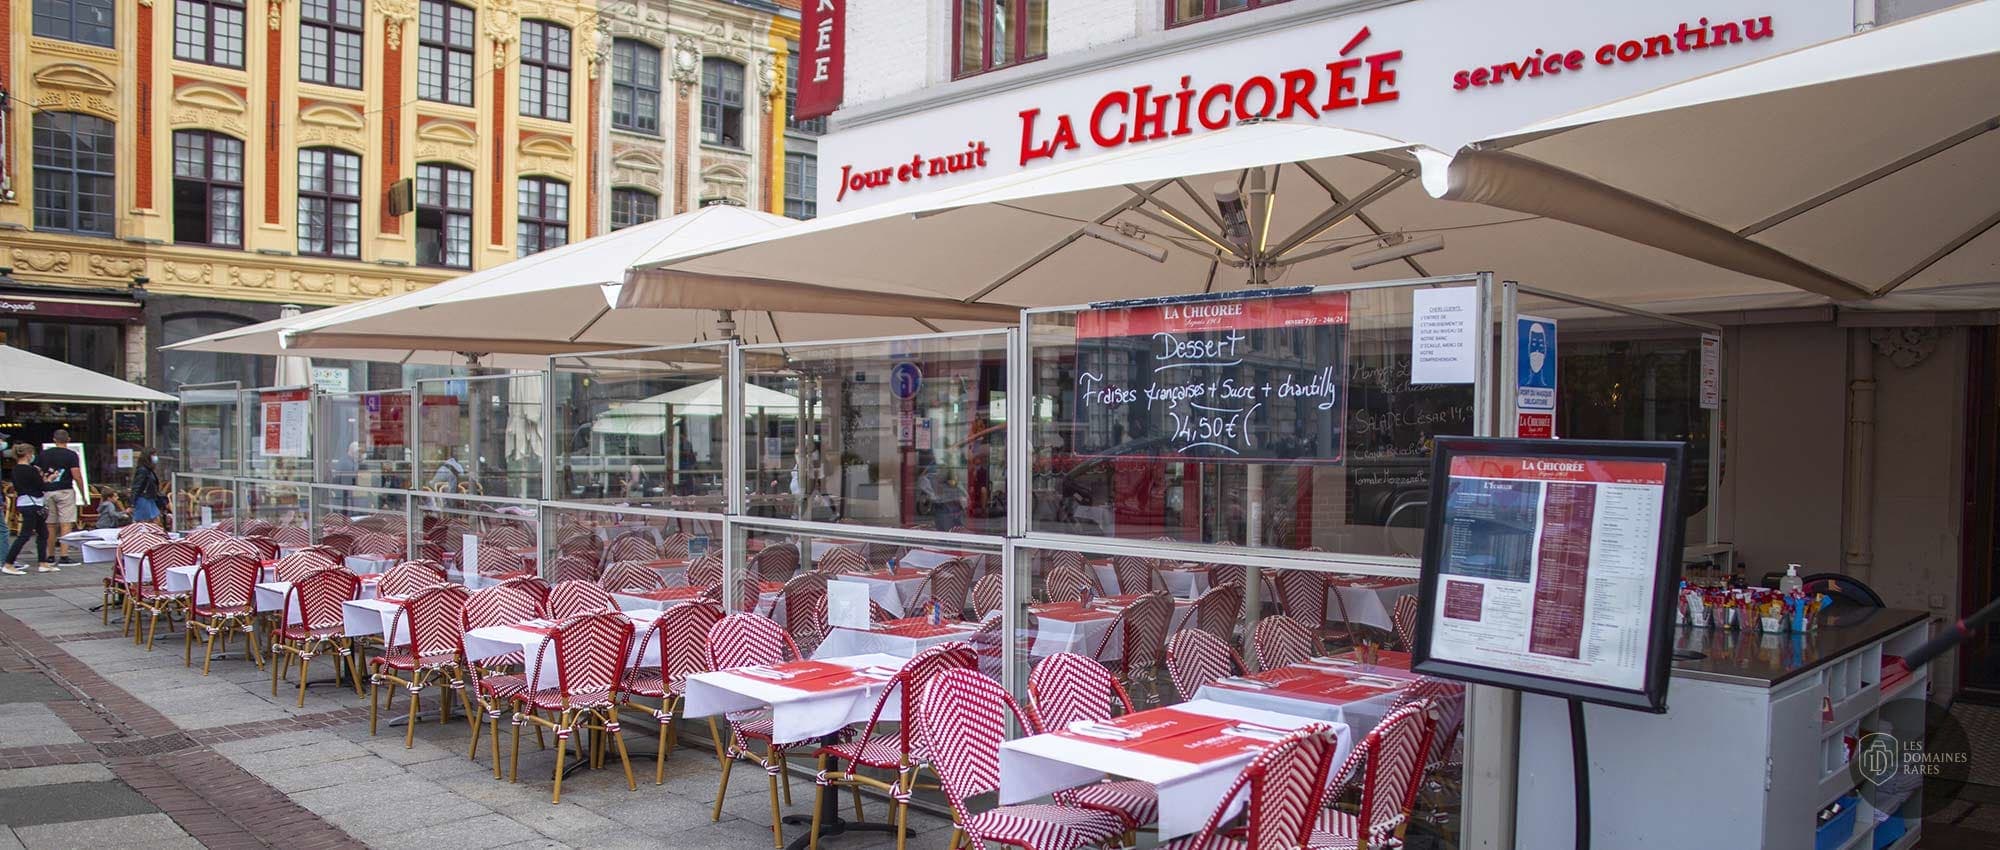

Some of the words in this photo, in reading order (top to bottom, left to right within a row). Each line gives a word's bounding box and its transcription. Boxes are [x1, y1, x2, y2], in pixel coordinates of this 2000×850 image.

[1453, 49, 1585, 91] service
[1594, 16, 1775, 66] continu
[836, 165, 893, 202] Jour
[897, 154, 925, 183] et
[927, 140, 990, 177] nuit
[1152, 329, 1245, 360] Dessert
[1079, 372, 1138, 407] Fraises
[1143, 381, 1205, 411] françaises
[1277, 366, 1336, 410] chantilly
